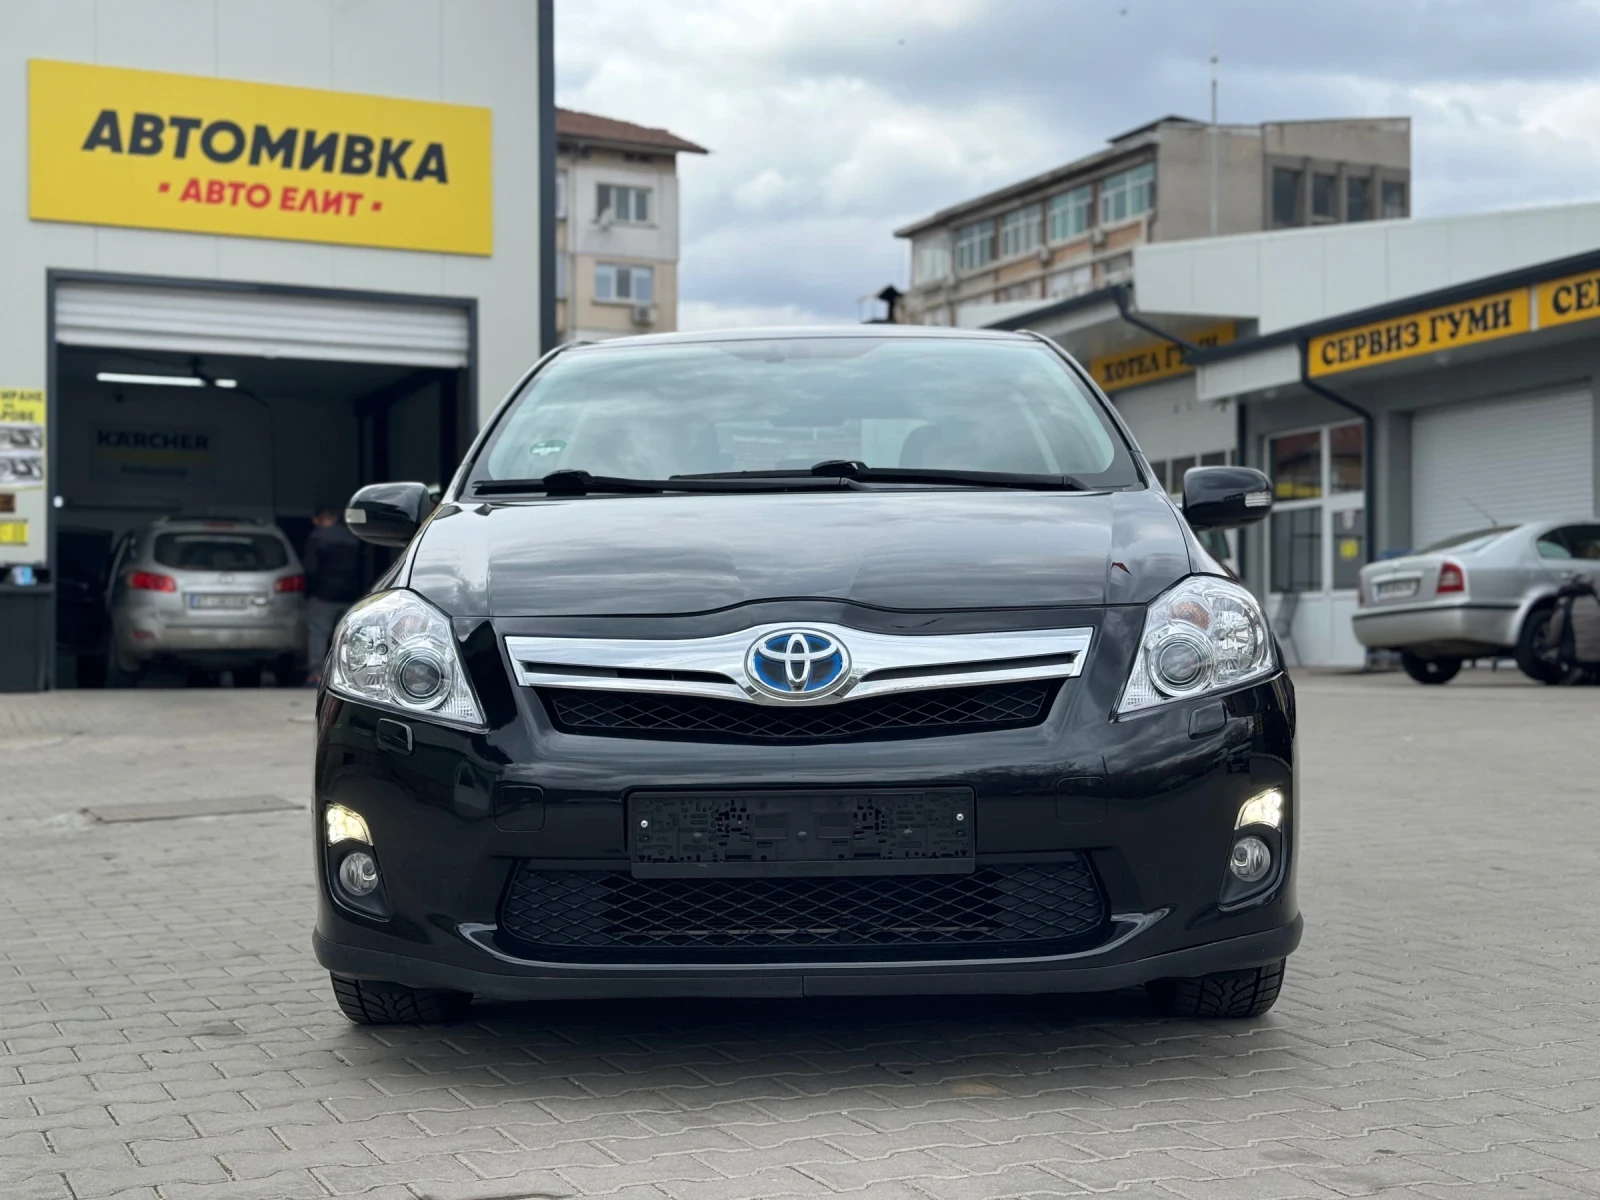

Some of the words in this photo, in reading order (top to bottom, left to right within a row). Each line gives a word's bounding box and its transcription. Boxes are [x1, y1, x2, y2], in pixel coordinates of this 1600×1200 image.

[81, 108, 450, 185] АВТОМИВКА
[178, 177, 272, 209] АВТО
[279, 186, 364, 216] ЕЛИТ
[1552, 277, 1600, 316] СЕ
[1321, 320, 1421, 366] СЕРВИЗ
[1429, 298, 1513, 343] ГУМИ
[1103, 350, 1161, 382] ХОТЕЛ
